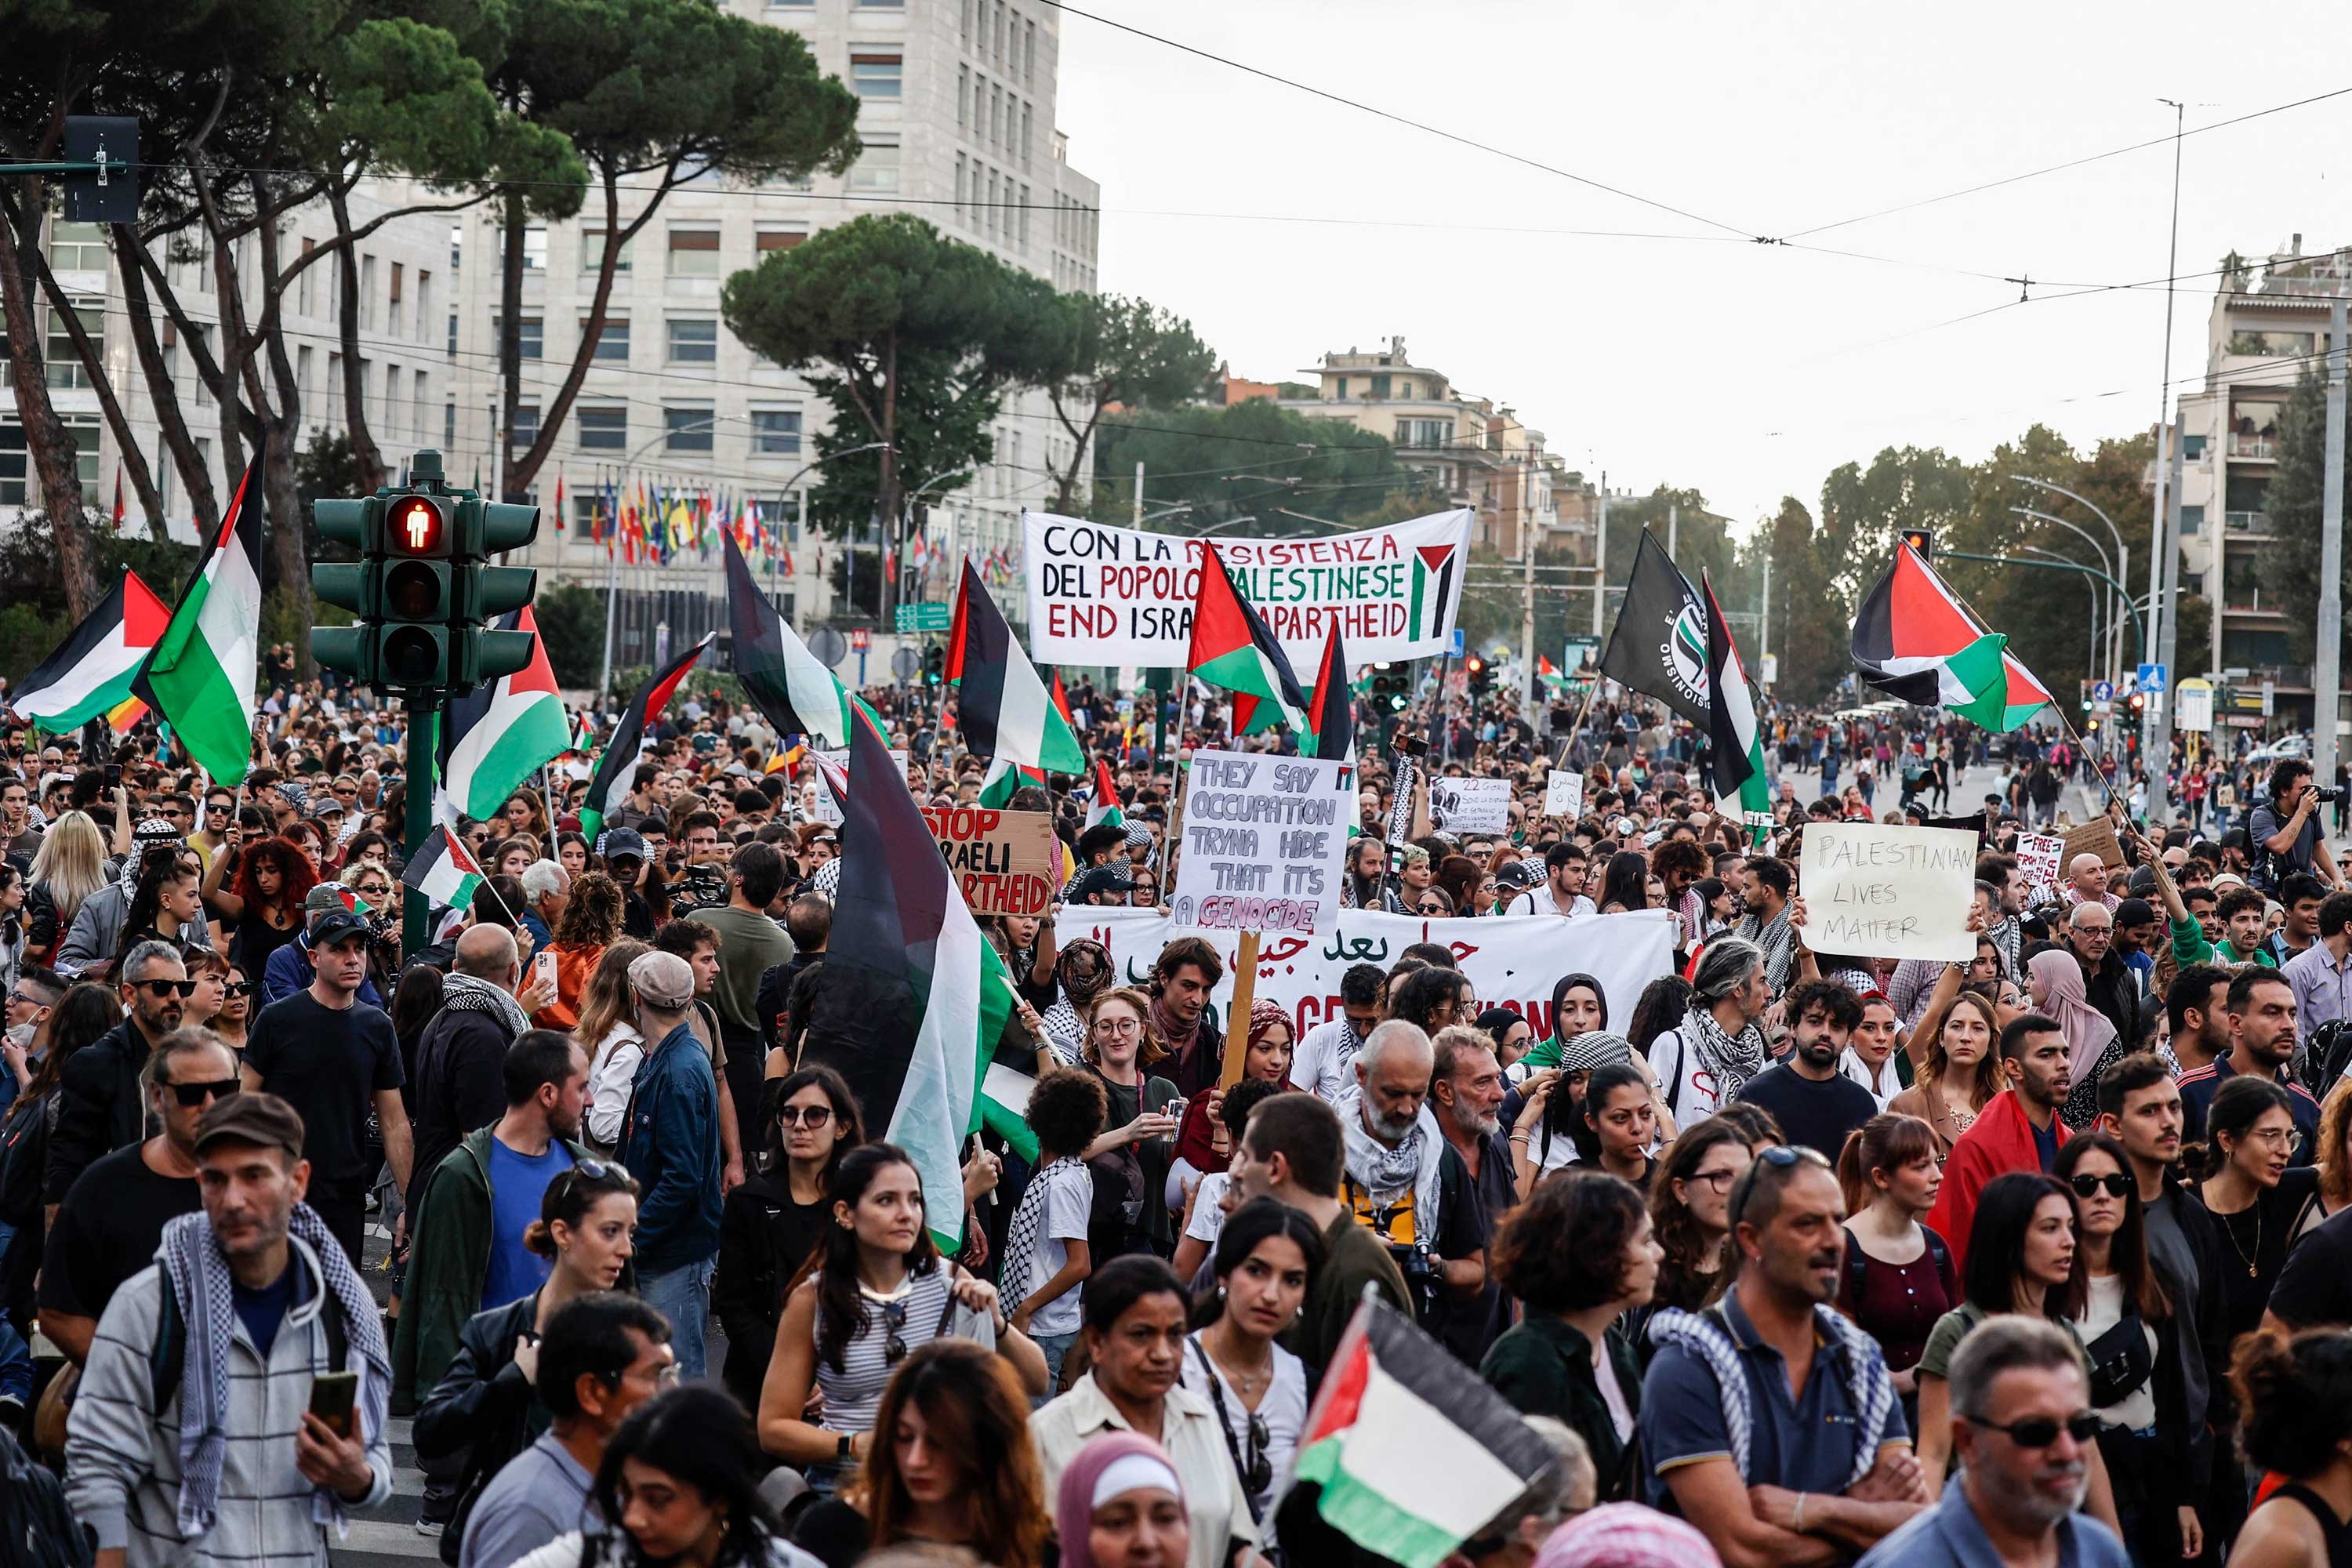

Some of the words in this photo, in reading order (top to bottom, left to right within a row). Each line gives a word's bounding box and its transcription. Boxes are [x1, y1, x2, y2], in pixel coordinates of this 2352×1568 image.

[1044, 526, 1120, 561] CON
[1134, 535, 1172, 561] LA
[1043, 562, 1091, 599] DEL
[1101, 564, 1201, 601] POPOLO
[1048, 604, 1117, 639] END
[1194, 757, 1258, 789] THEY
[1273, 764, 1319, 793] SAY
[1462, 779, 1480, 791] 22
[920, 807, 1000, 841] STOP
[939, 840, 1011, 873] RAELI
[1189, 826, 1258, 858] TRYNA
[1818, 835, 1975, 873] PALESTINIAN
[2031, 837, 2053, 853] FREE
[2016, 853, 2038, 866] FROM
[2042, 859, 2057, 888] SEA
[1210, 862, 1272, 892] THAT
[953, 873, 1048, 915] RTHEID
[1833, 882, 1897, 906] LIVES
[1175, 895, 1194, 926] A
[1823, 914, 1923, 944] MATTER
[1229, 936, 1309, 978] جي
